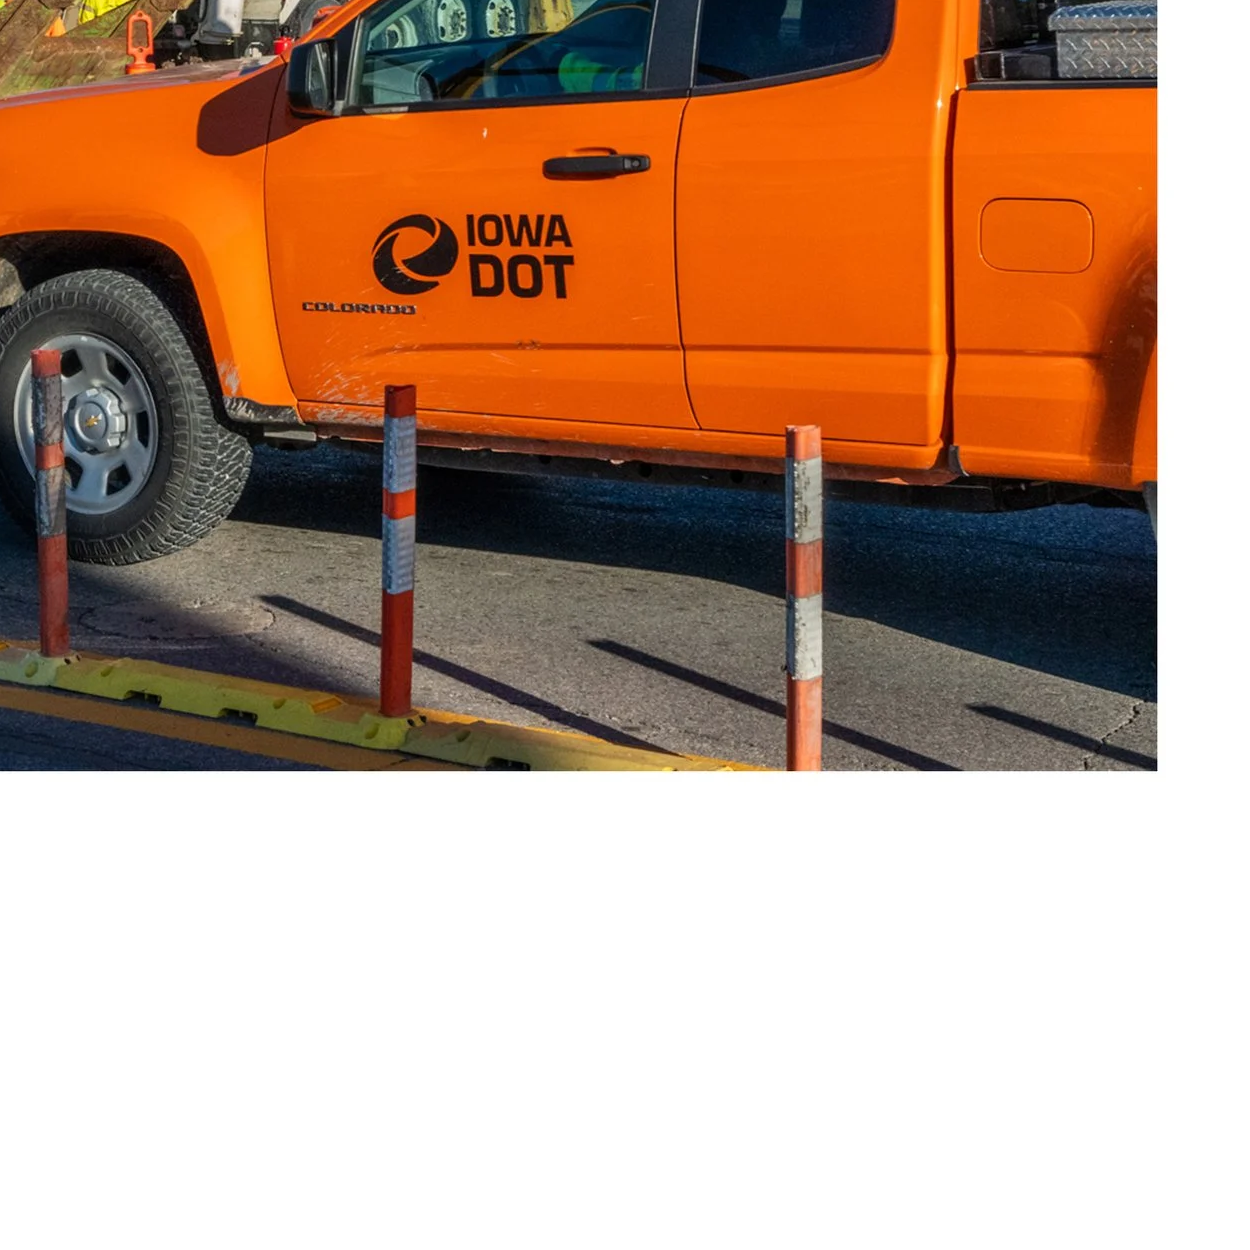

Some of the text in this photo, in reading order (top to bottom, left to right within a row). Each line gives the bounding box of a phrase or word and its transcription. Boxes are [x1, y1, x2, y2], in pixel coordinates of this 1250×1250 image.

[466, 214, 572, 247] IOWA
[469, 254, 574, 299] DOT
[302, 301, 417, 315] COLORADO
